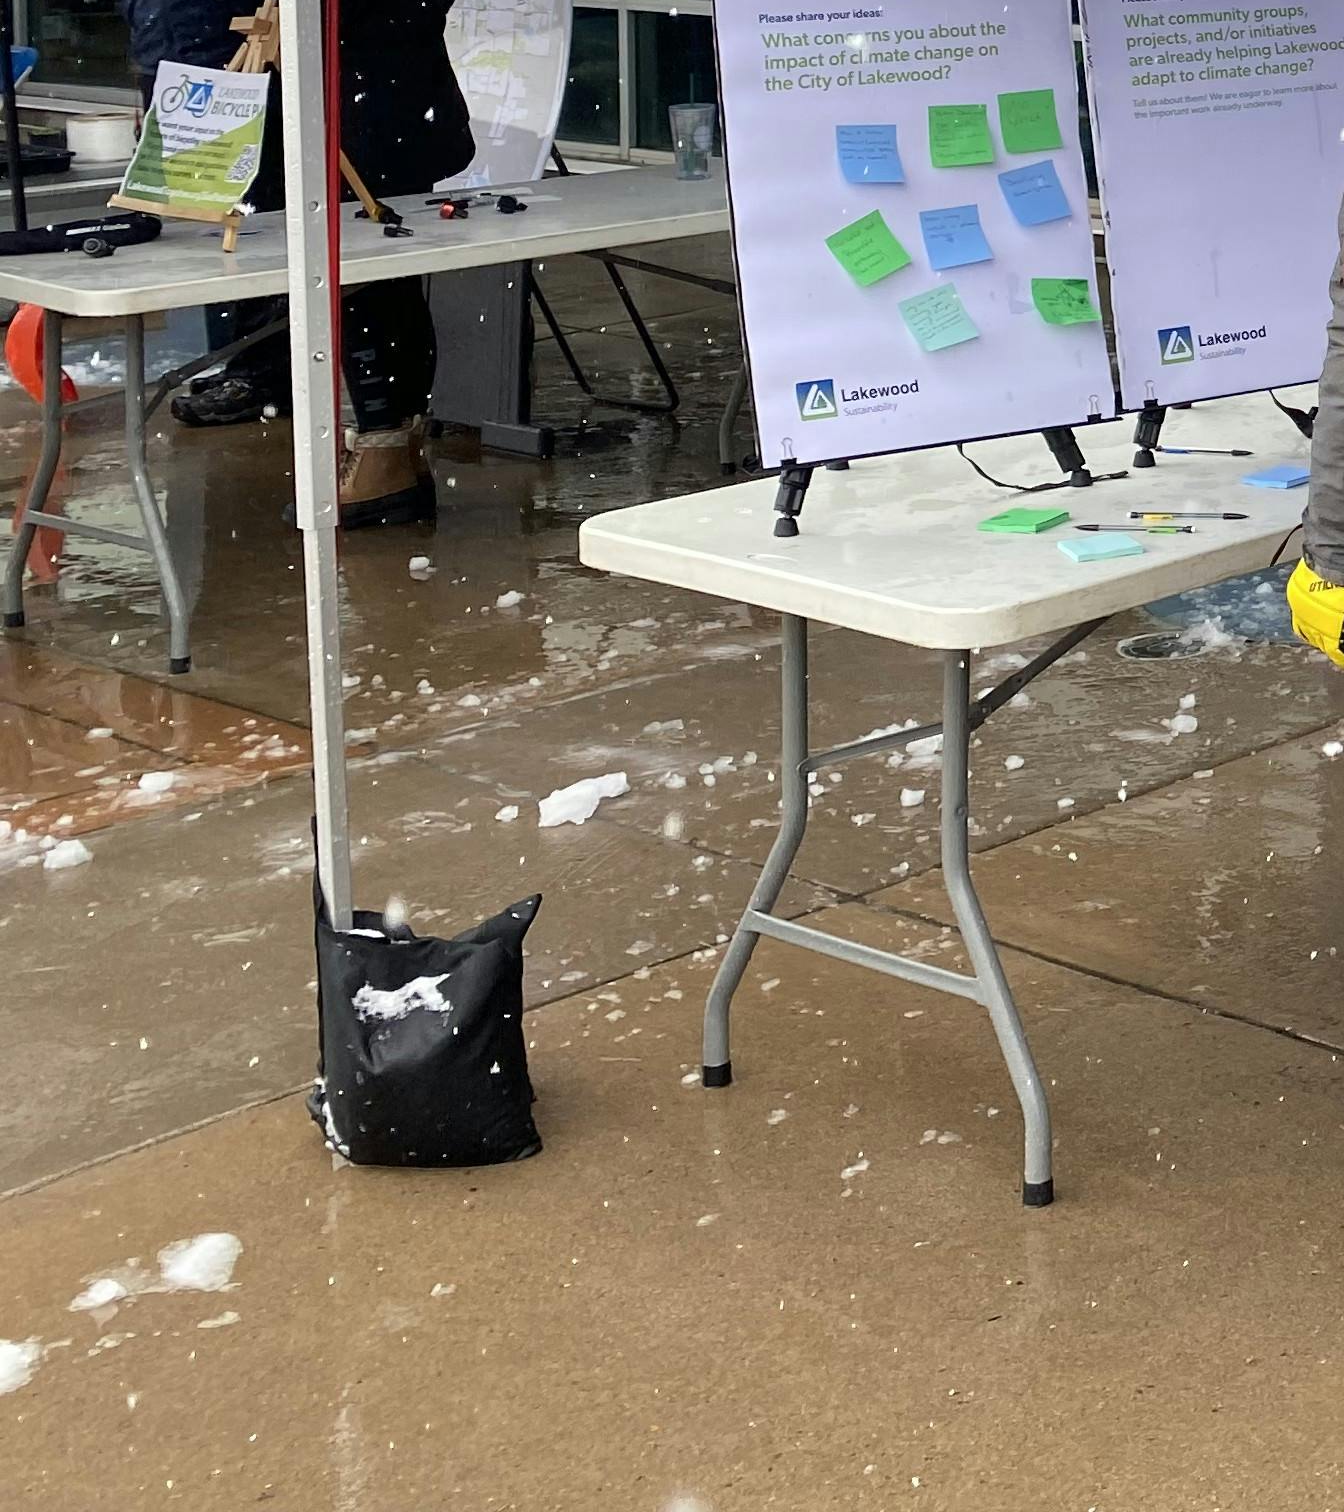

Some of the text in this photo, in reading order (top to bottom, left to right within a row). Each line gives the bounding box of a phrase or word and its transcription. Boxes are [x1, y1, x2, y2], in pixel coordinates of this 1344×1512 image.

[758, 8, 884, 24] Please share your ideas:
[1124, 6, 1309, 28] What community groups,
[761, 22, 1006, 48] What conrns you about the
[1126, 24, 1317, 50] projects, and/or initiatives
[764, 44, 999, 72] impact of clmate change on
[1129, 54, 1159, 67] are
[1157, 49, 1212, 65] already
[1216, 44, 1271, 60] helping
[765, 65, 951, 92] the City of Lakewood?
[1132, 58, 1314, 87] adapt to climate change?
[1159, 96, 1184, 105] about
[1209, 92, 1223, 101] We
[1224, 92, 1238, 100] are
[1263, 88, 1272, 96] to
[1134, 111, 1147, 119] the
[1149, 106, 1190, 118] important
[1197, 325, 1268, 348] Lakewood
[1198, 346, 1247, 362] Sustainability
[841, 380, 920, 403] Lakewood
[842, 400, 898, 418] Sustainability
